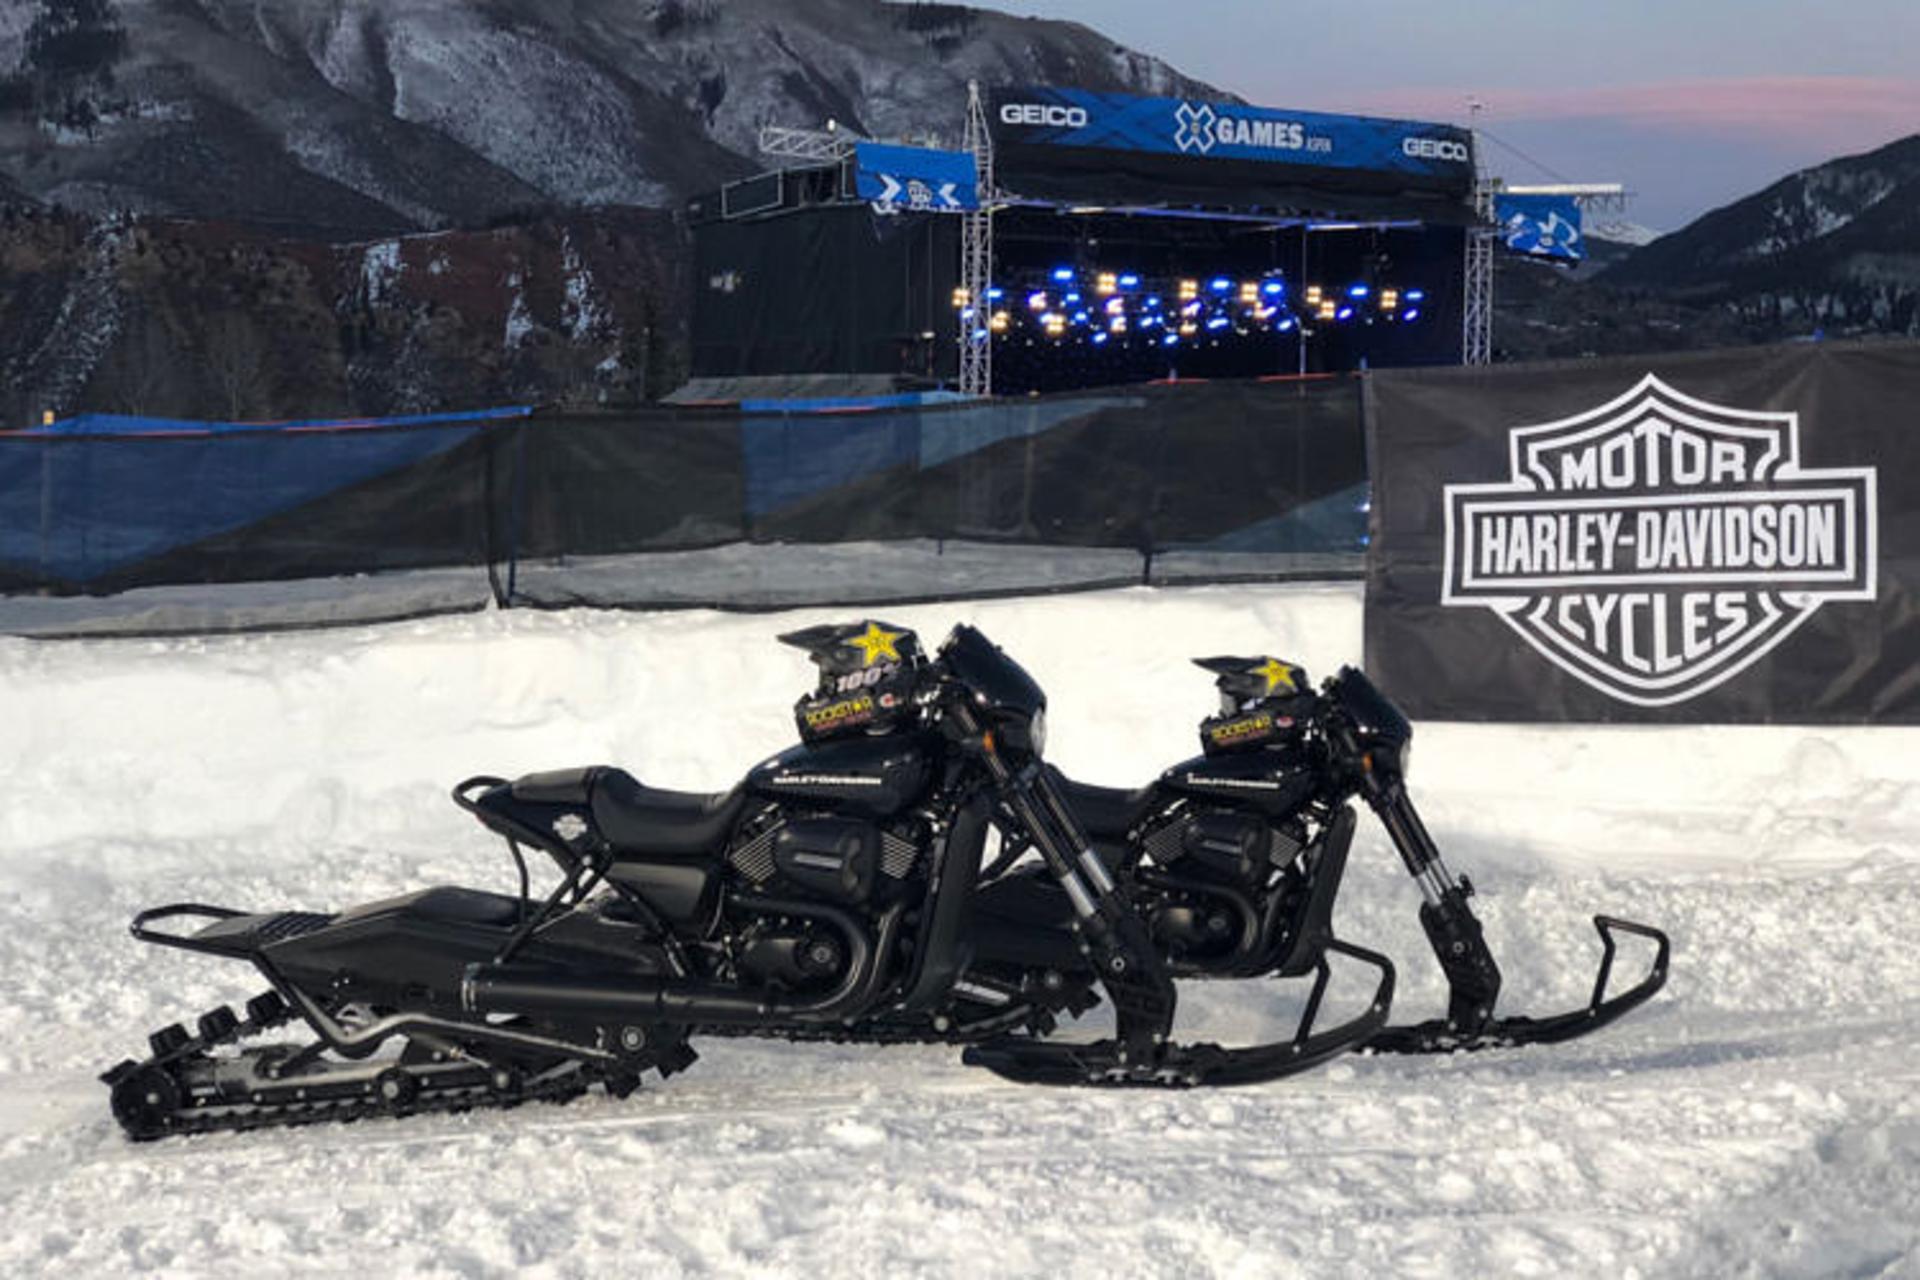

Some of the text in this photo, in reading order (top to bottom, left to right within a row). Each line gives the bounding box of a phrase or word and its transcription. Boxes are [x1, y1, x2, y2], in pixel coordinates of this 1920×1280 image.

[1000, 103, 1087, 128] GEICO
[1216, 117, 1304, 149] GAMES
[1402, 137, 1468, 162] GEICO
[1561, 416, 1747, 490] MOTOR
[1480, 503, 1836, 575] HARLEY-DAVIDSON
[1558, 591, 1749, 674] CYCLES
